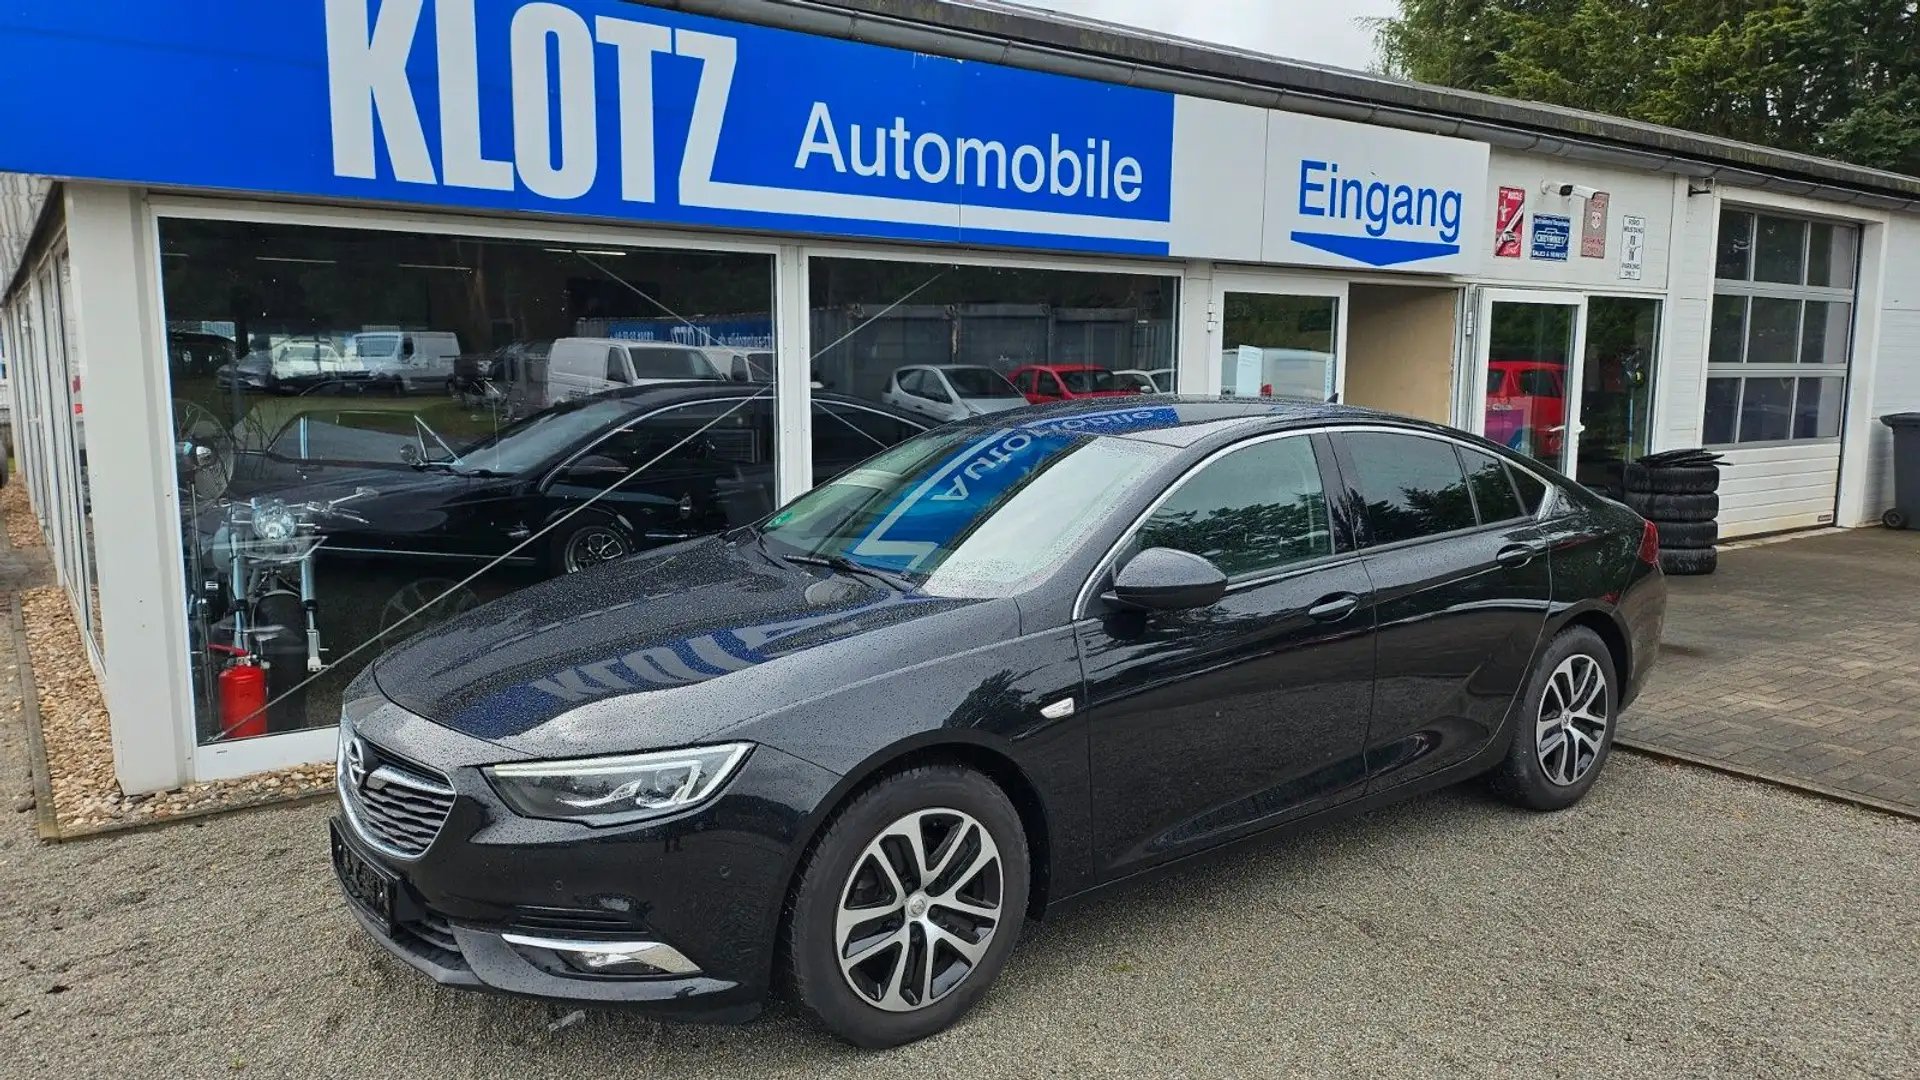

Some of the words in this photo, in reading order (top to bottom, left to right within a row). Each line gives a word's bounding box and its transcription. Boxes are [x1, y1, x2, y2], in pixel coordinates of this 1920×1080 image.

[325, 0, 738, 207] KLOTZ
[794, 101, 1143, 203] Automobile
[1299, 159, 1462, 243] Eingang
